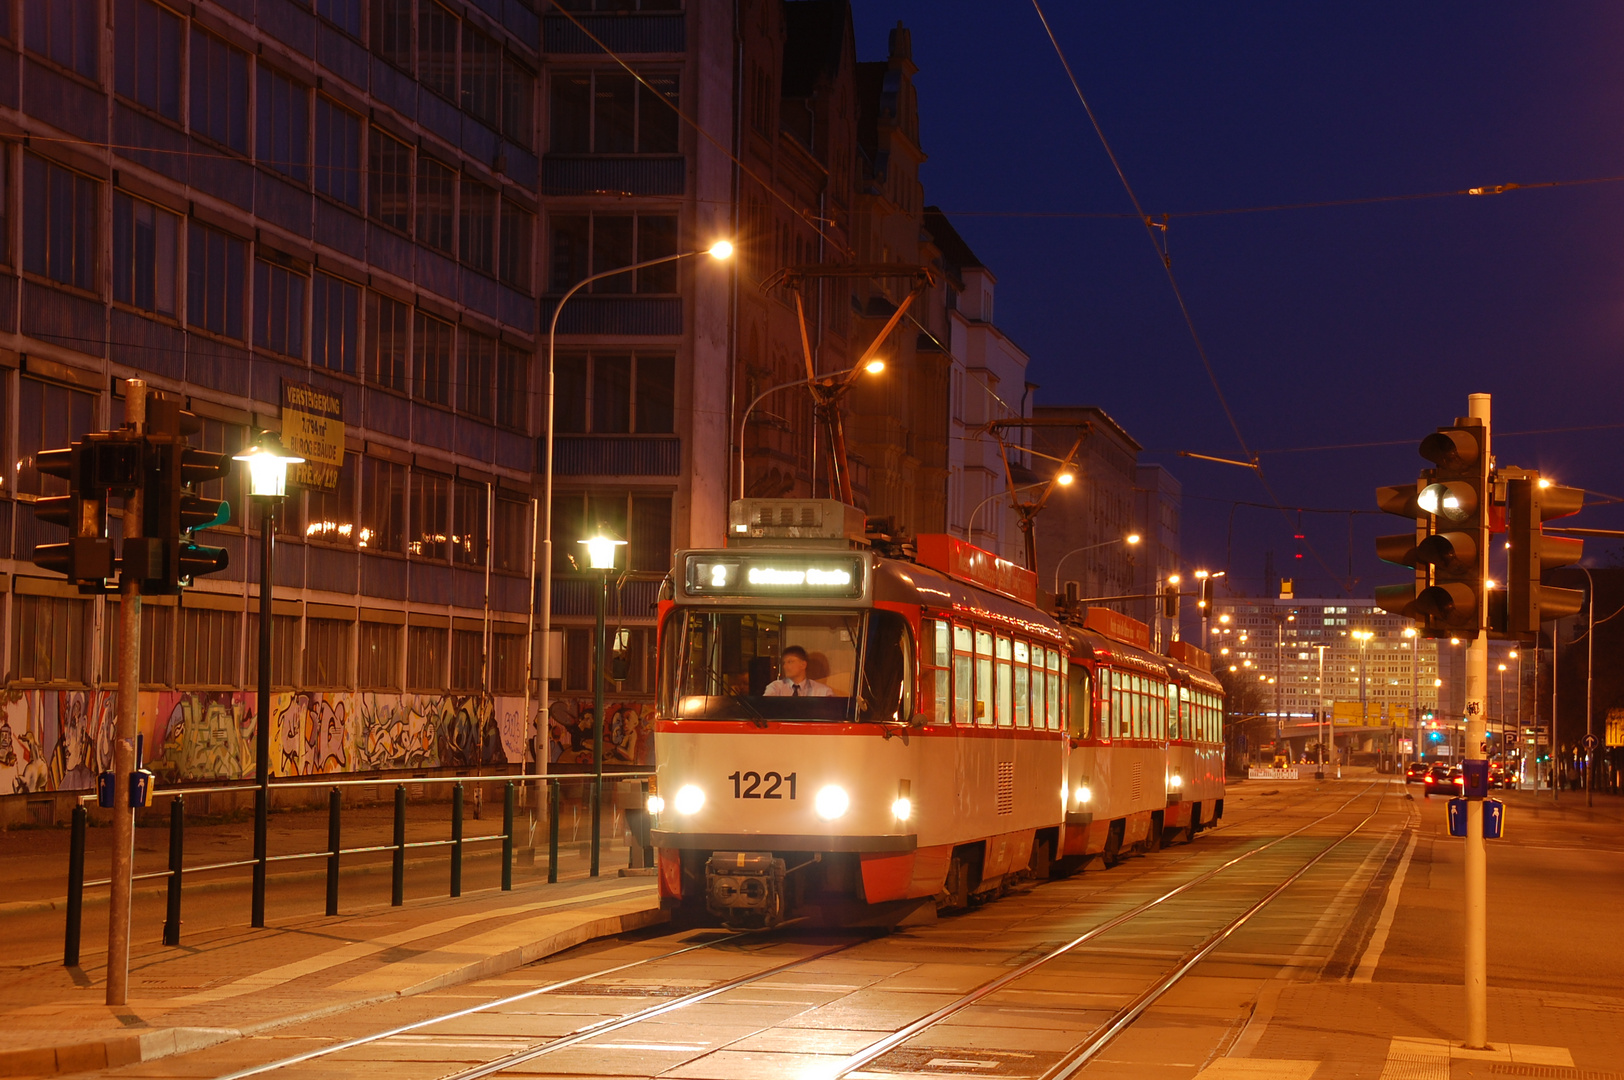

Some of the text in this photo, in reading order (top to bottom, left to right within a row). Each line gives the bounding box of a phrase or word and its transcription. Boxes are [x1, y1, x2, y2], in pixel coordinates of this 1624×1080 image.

[287, 386, 339, 414] VERSTEIGERUNG
[291, 434, 336, 460] BÜROGEBÄUDE
[712, 565, 726, 586] 2
[1506, 735, 1514, 744] P
[728, 771, 797, 800] 1221
